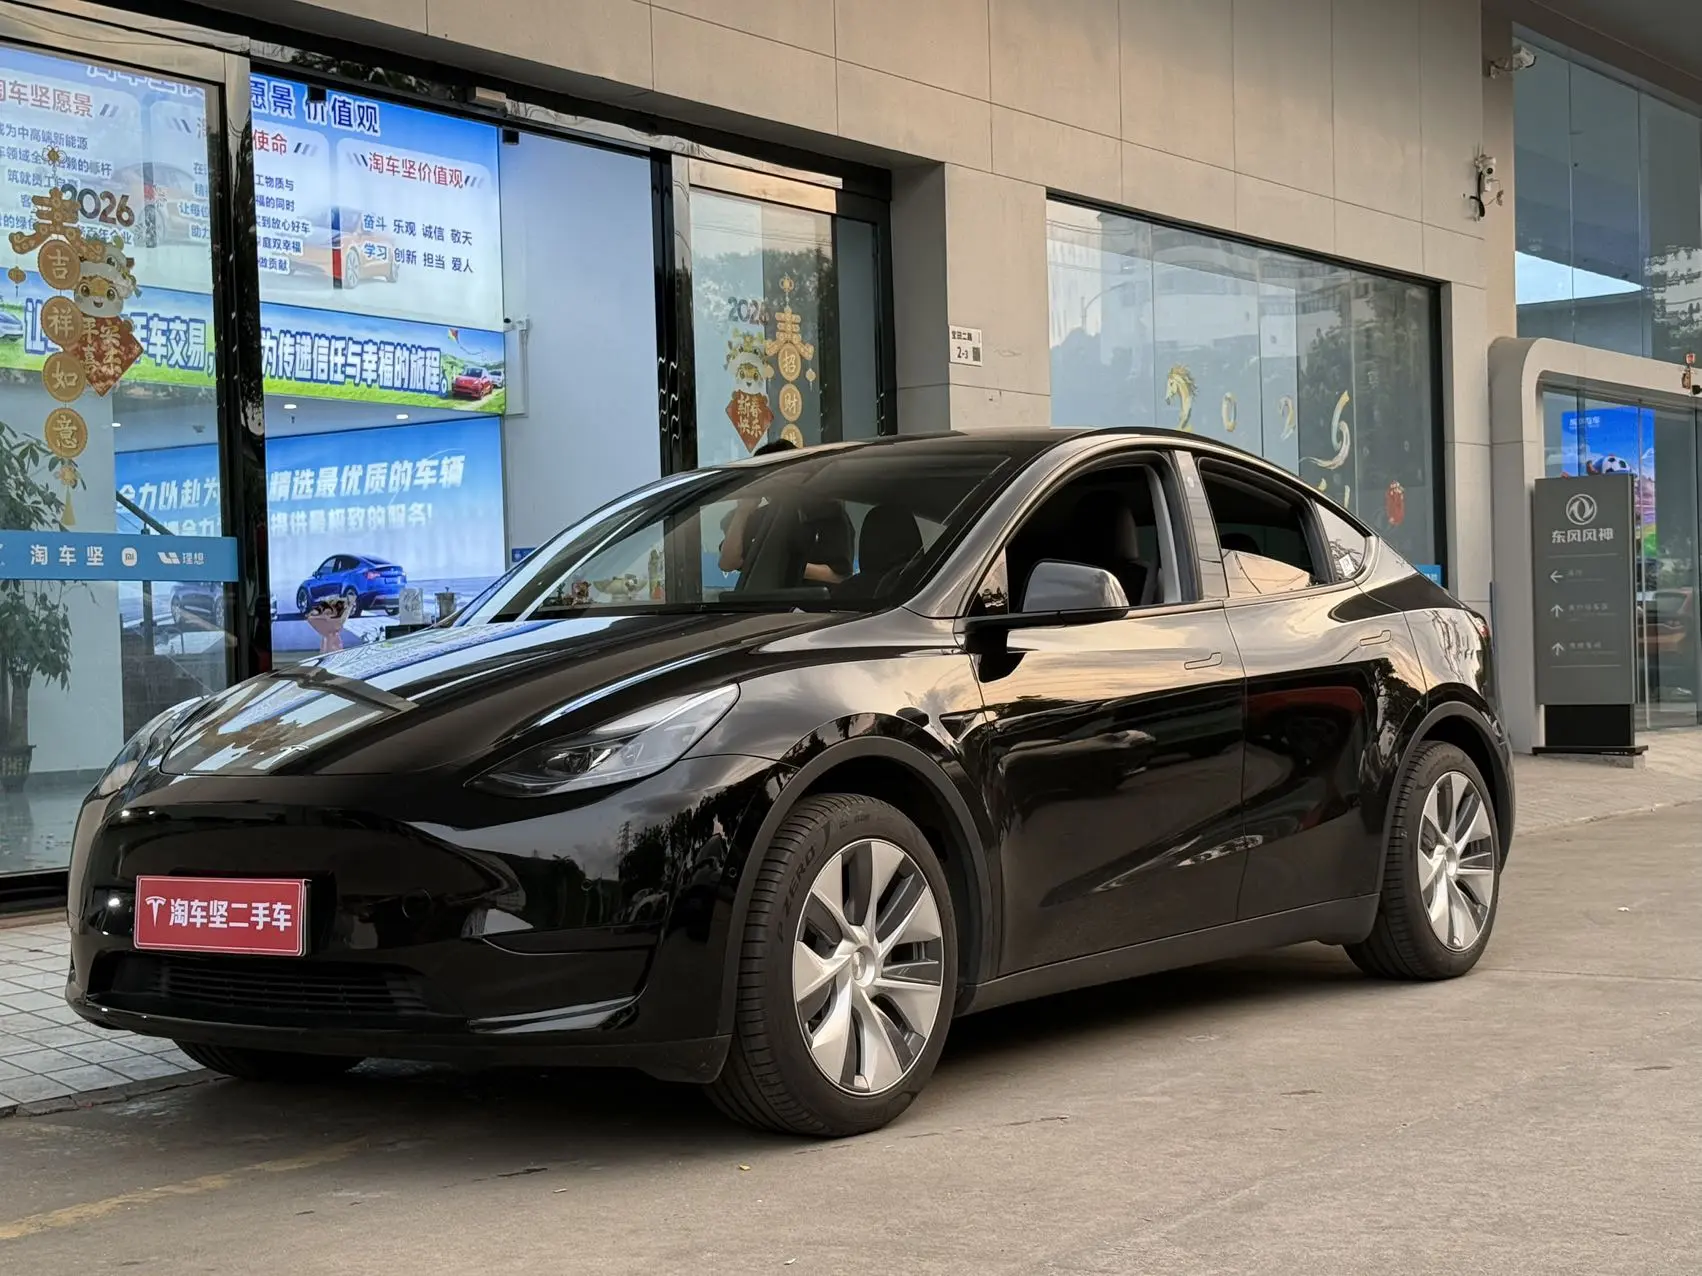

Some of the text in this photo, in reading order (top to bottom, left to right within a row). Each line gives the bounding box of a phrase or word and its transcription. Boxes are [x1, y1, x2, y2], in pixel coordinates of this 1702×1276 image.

[253, 129, 287, 156] 使命
[369, 151, 463, 188] 淘车坚价值观
[257, 236, 302, 253] 庭双幸福
[364, 214, 473, 246] 奋斗 乐观 诚信 敬天
[364, 243, 474, 273] 学习 创新 担当 爱人
[45, 249, 78, 449] 吉祥如意
[270, 455, 465, 503] 精选最优质的车辆
[1551, 527, 1615, 543] 东风风神
[30, 544, 105, 566] 淘车坚
[169, 899, 293, 932] 淘车坚二手车
